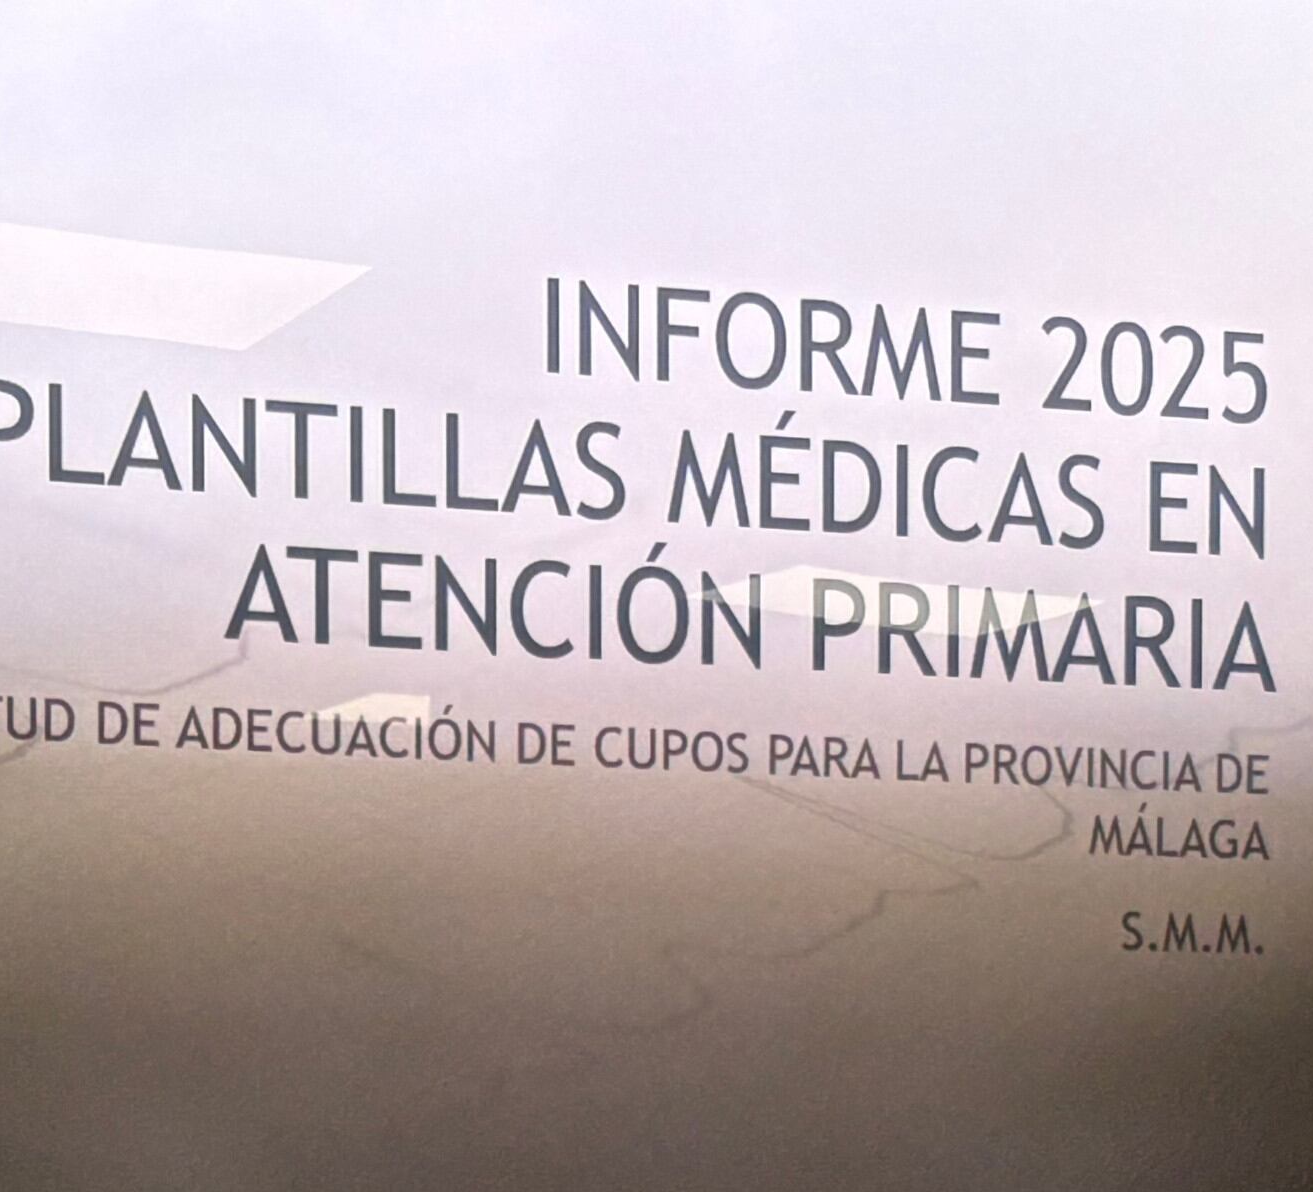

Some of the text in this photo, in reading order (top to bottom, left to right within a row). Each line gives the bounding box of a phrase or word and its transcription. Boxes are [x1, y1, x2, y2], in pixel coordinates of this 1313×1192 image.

[547, 277, 1267, 424] INFORME 2025
[667, 410, 1105, 549] MÉDICAS
[1149, 461, 1265, 560] EN
[224, 542, 1277, 692] ATENCIÓN PRIMARIA
[97, 701, 160, 747] DE
[176, 704, 496, 763] ADECUACIÓN
[518, 723, 576, 767] DE
[595, 727, 749, 774] CUPOS
[769, 735, 881, 780] PARA
[896, 741, 949, 783] LA
[965, 744, 1202, 792] PROVINCIA
[1217, 753, 1270, 795] DE
[1089, 803, 1270, 860] MÁLAGA
[1121, 911, 1265, 955] S.M.M.
